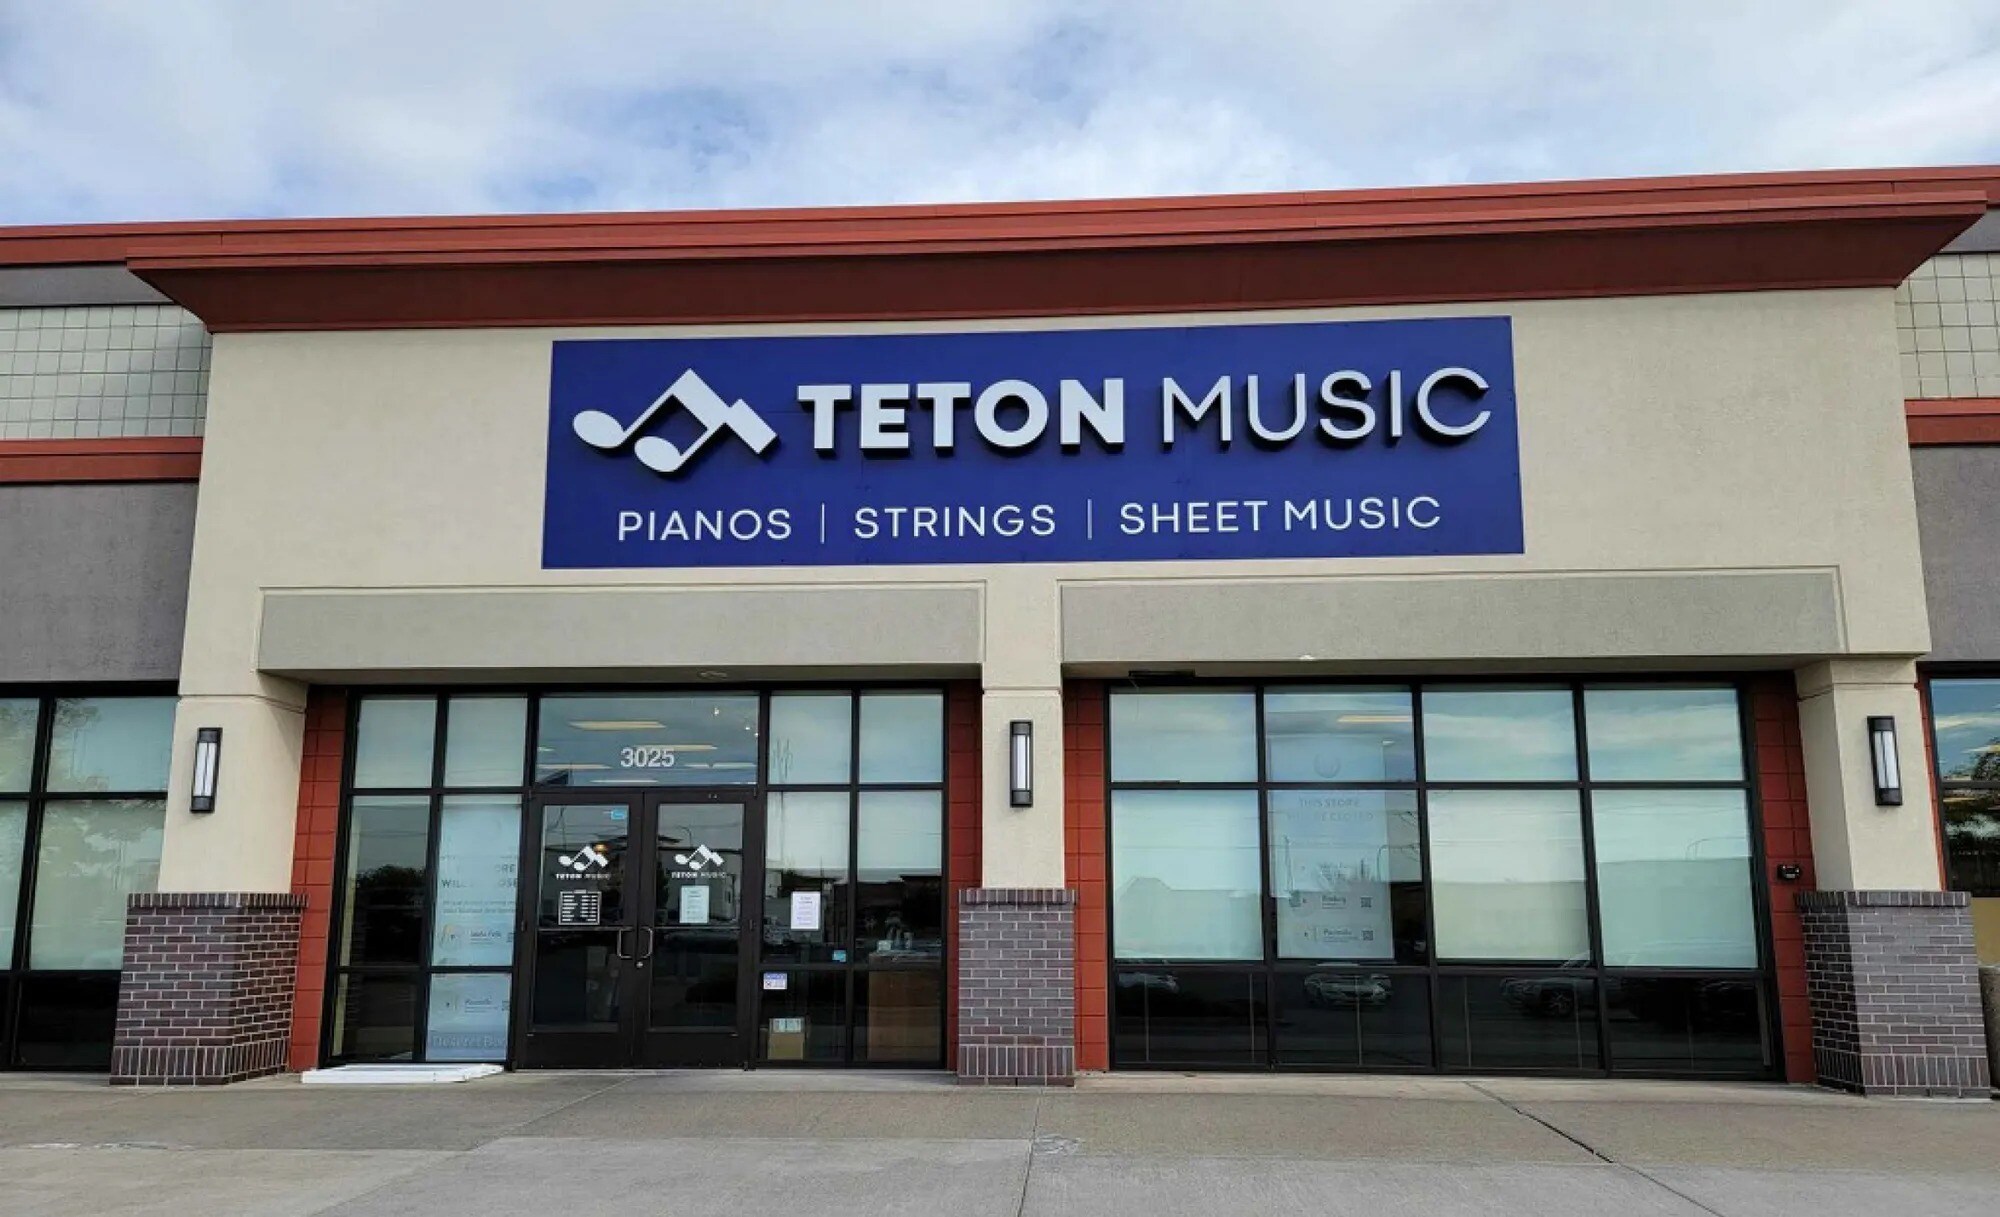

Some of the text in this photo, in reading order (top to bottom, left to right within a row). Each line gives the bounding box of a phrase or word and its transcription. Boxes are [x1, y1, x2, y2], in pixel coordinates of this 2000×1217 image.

[797, 367, 1492, 451] TETON MUSIC
[617, 496, 1441, 541] PIANOS STRINGS SHEET MUSIC
[620, 747, 675, 767] 3025
